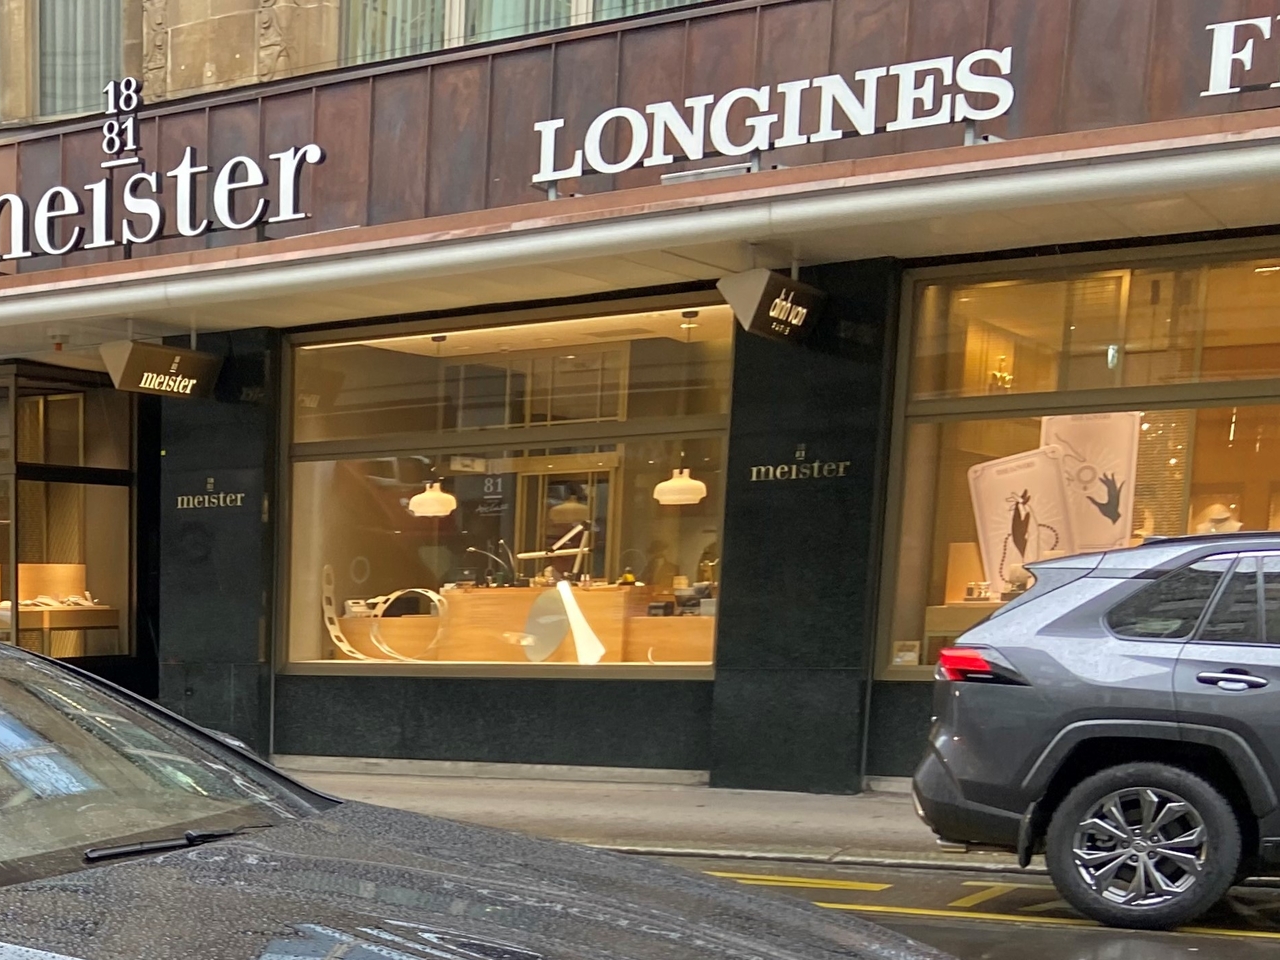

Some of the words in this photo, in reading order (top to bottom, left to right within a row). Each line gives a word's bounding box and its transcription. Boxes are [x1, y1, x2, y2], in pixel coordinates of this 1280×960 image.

[1199, 14, 1280, 97] F
[102, 76, 138, 114] 18
[532, 46, 1015, 183] LONGINES
[101, 116, 137, 154] 81
[139, 371, 197, 394] meister
[750, 459, 851, 481] meister
[177, 491, 246, 509] meister
